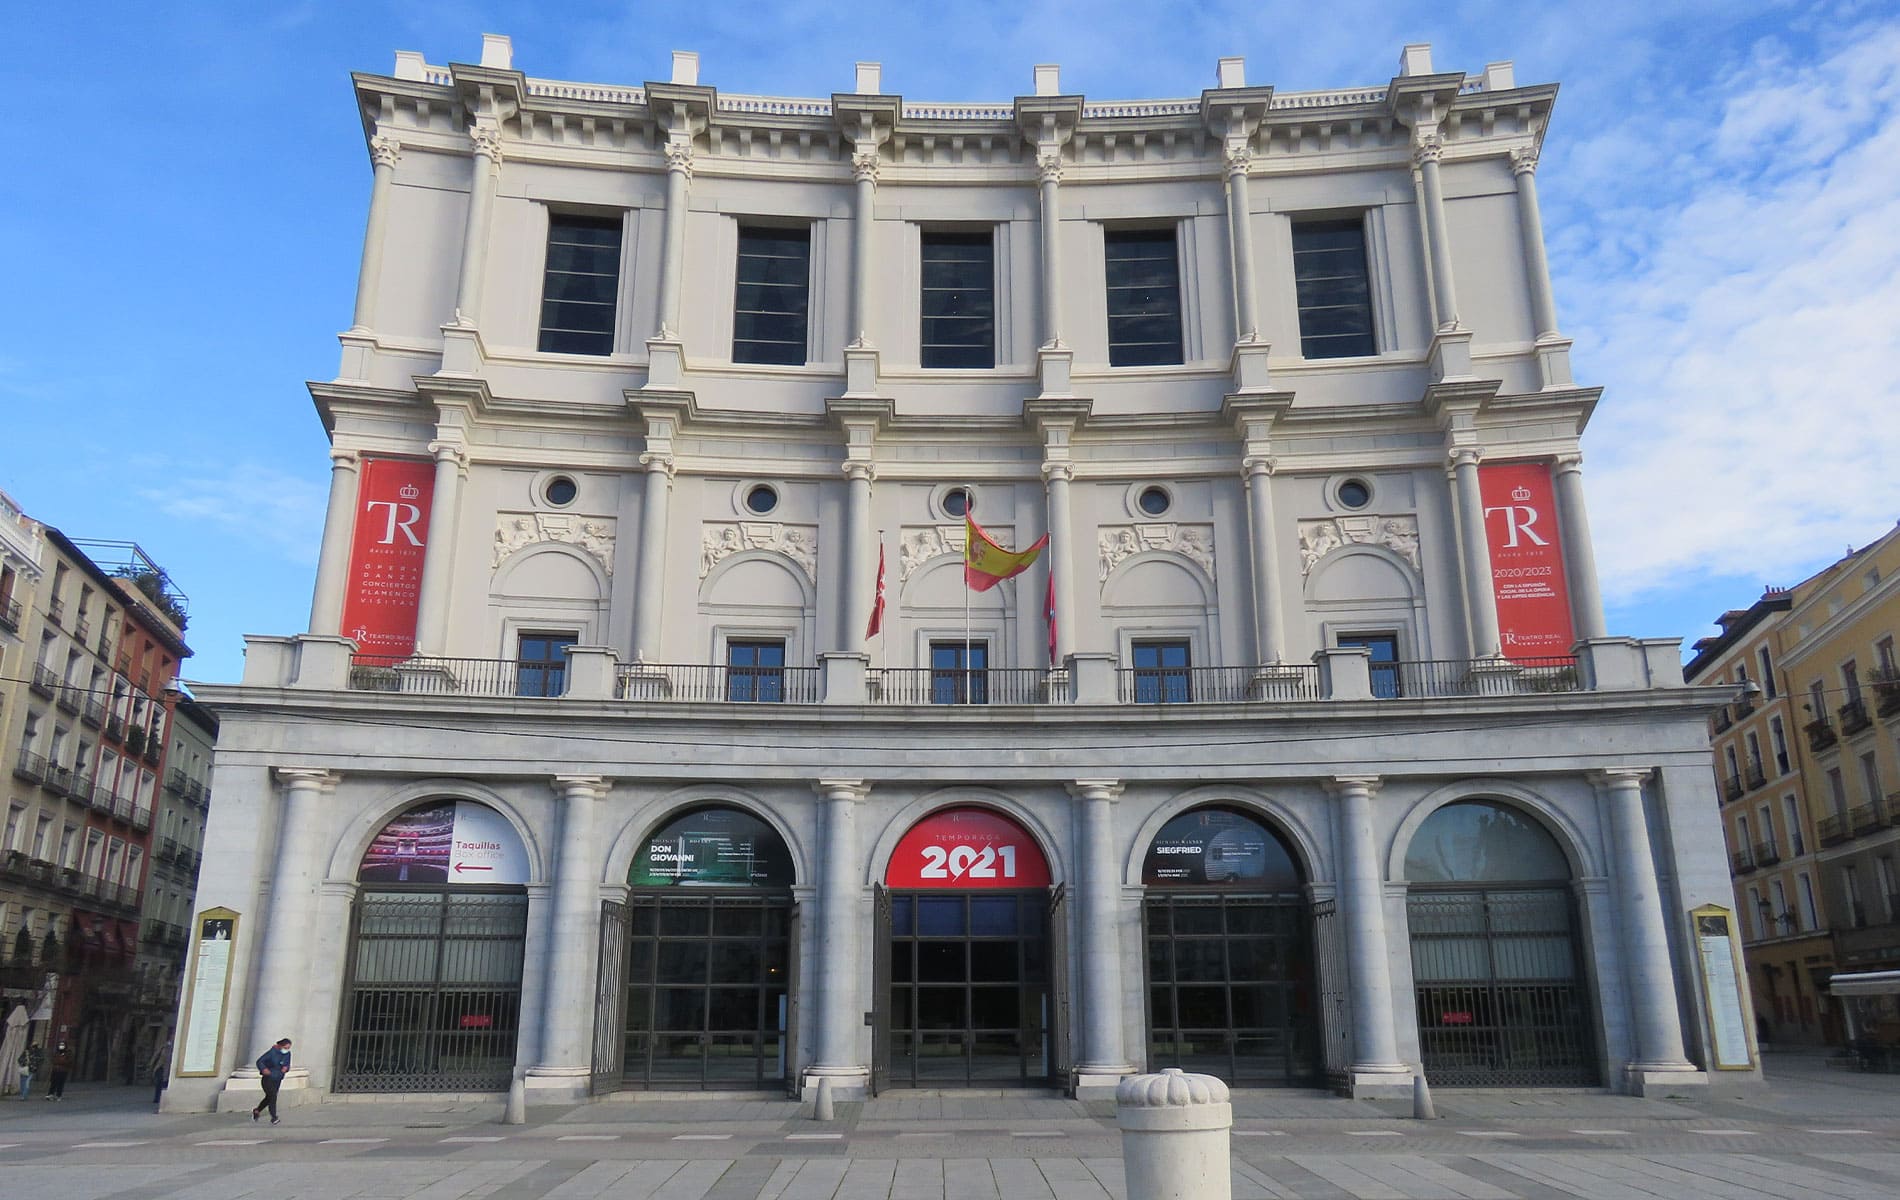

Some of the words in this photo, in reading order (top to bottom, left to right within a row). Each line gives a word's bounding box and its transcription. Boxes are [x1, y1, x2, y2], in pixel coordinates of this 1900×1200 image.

[363, 572, 417, 580] DANZA
[1494, 566, 1553, 578] 2020/2023
[362, 581, 417, 590] CONCIERTOS
[361, 589, 415, 597] FLAMENCO
[360, 598, 414, 606] VISITAS
[455, 841, 501, 850] Taquillas
[650, 845, 672, 853] DON
[1156, 846, 1202, 854] SIEGFRIED
[650, 854, 695, 862] GIOVANNI
